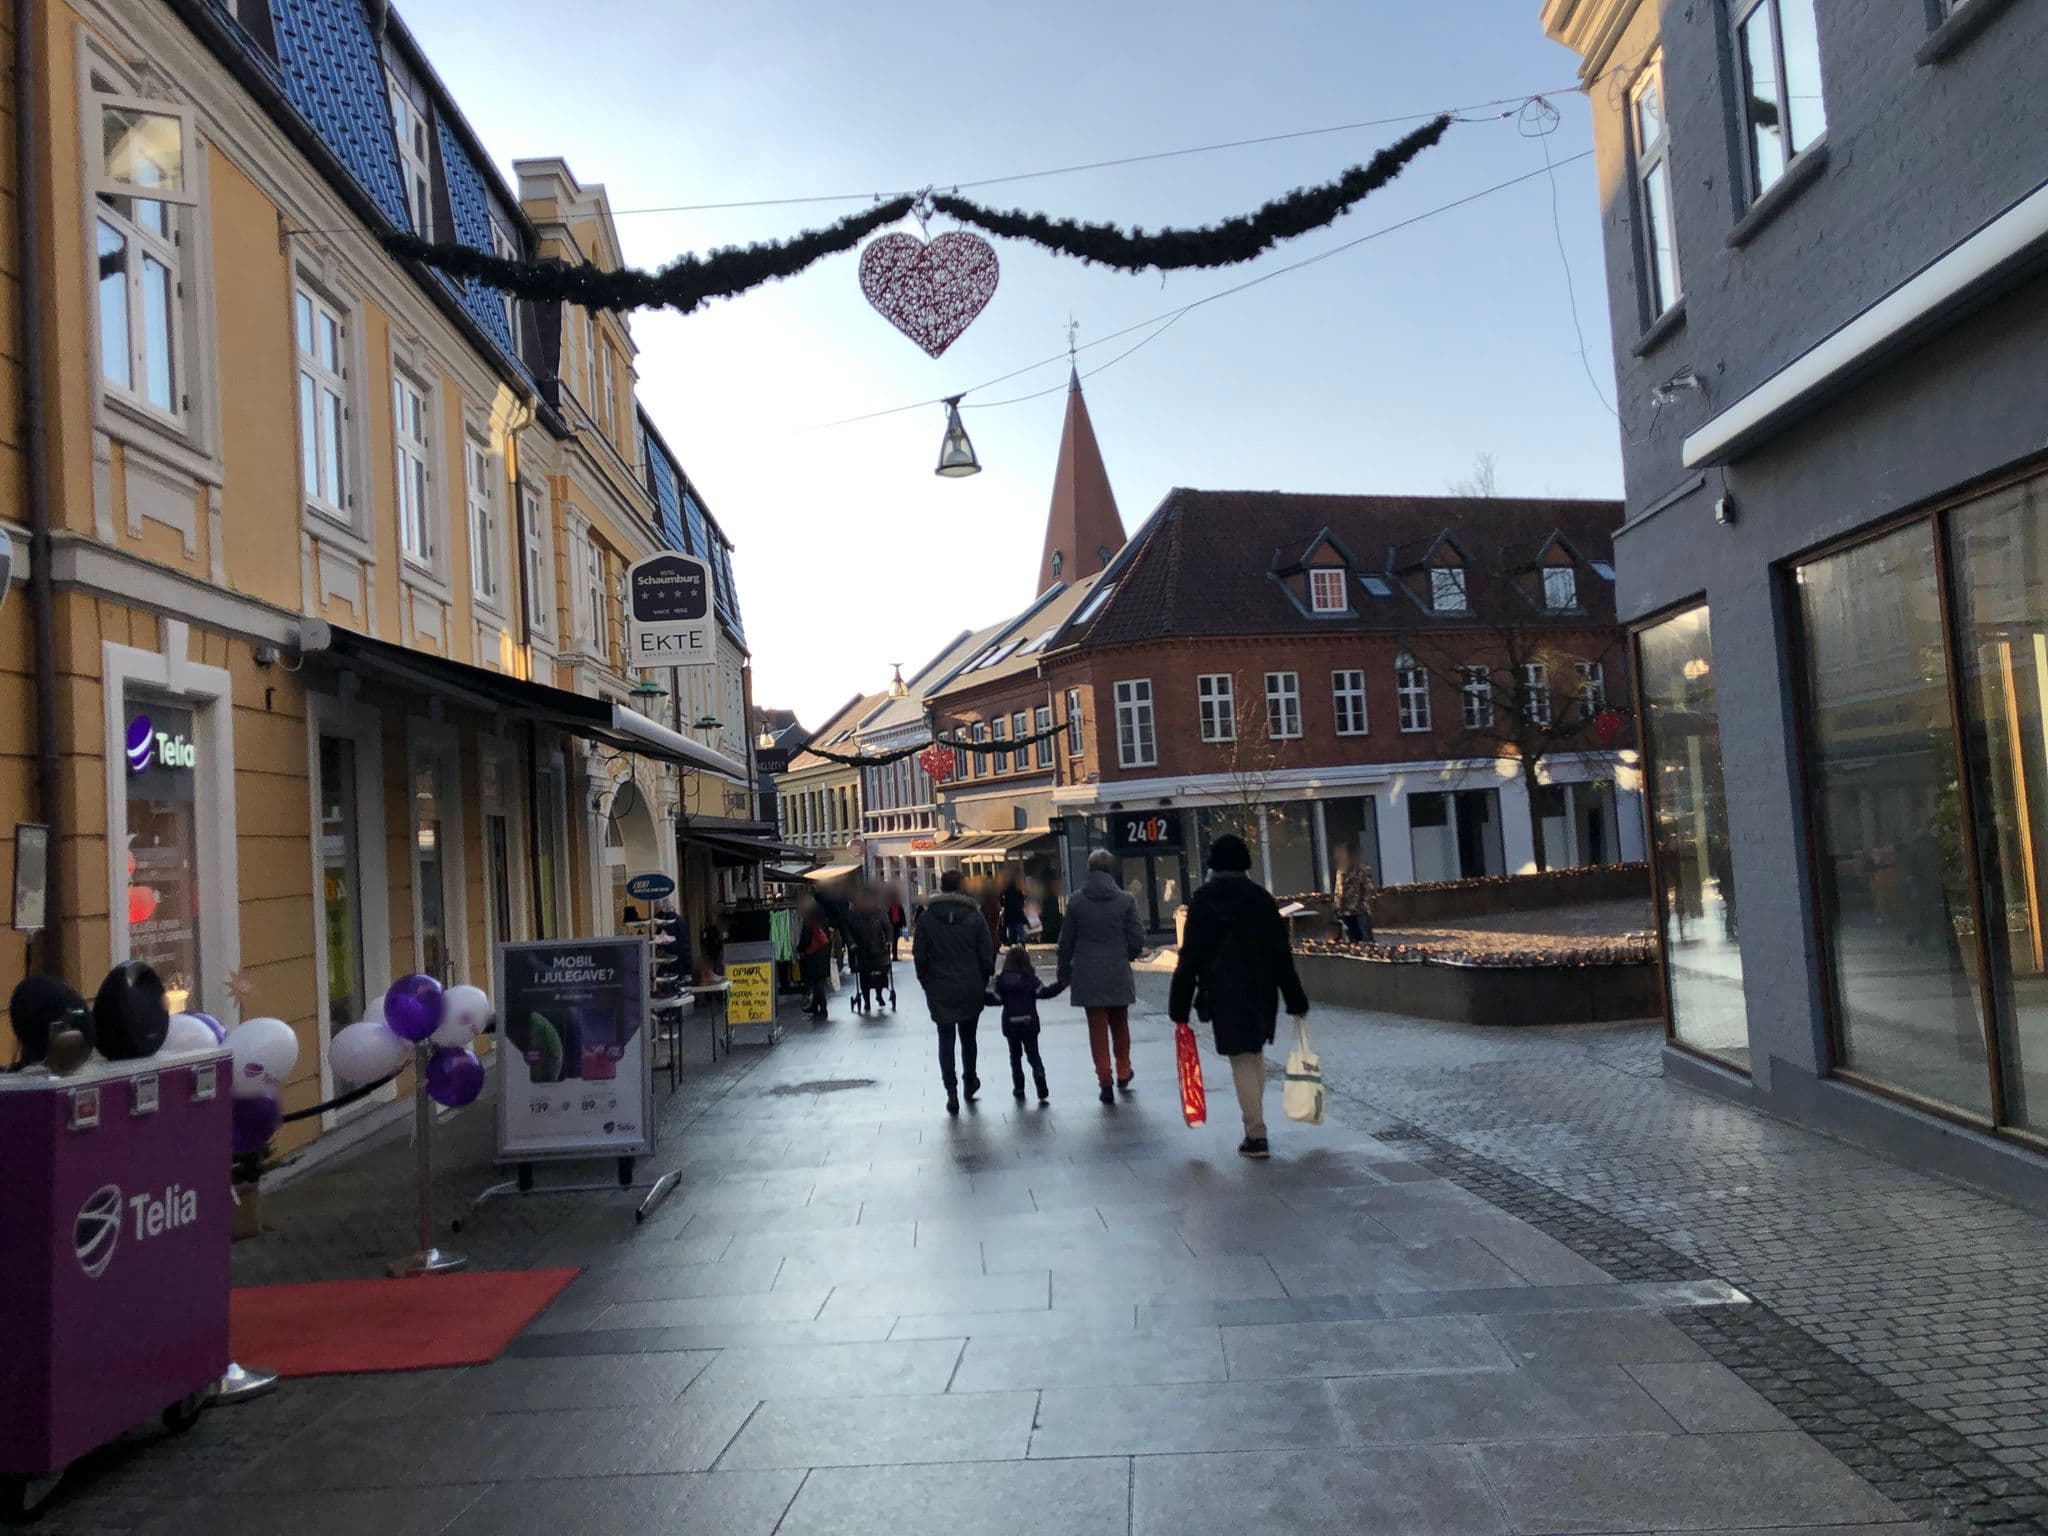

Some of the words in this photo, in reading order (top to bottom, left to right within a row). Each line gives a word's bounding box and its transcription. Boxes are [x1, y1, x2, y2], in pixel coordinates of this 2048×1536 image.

[637, 574, 700, 586] Schaumburg
[640, 630, 703, 651] EKTE
[155, 731, 195, 768] Telia
[553, 955, 596, 969] MOBIL
[534, 972, 538, 983] I
[541, 967, 615, 984] JULEGAVE?
[129, 1183, 197, 1241] Telia
